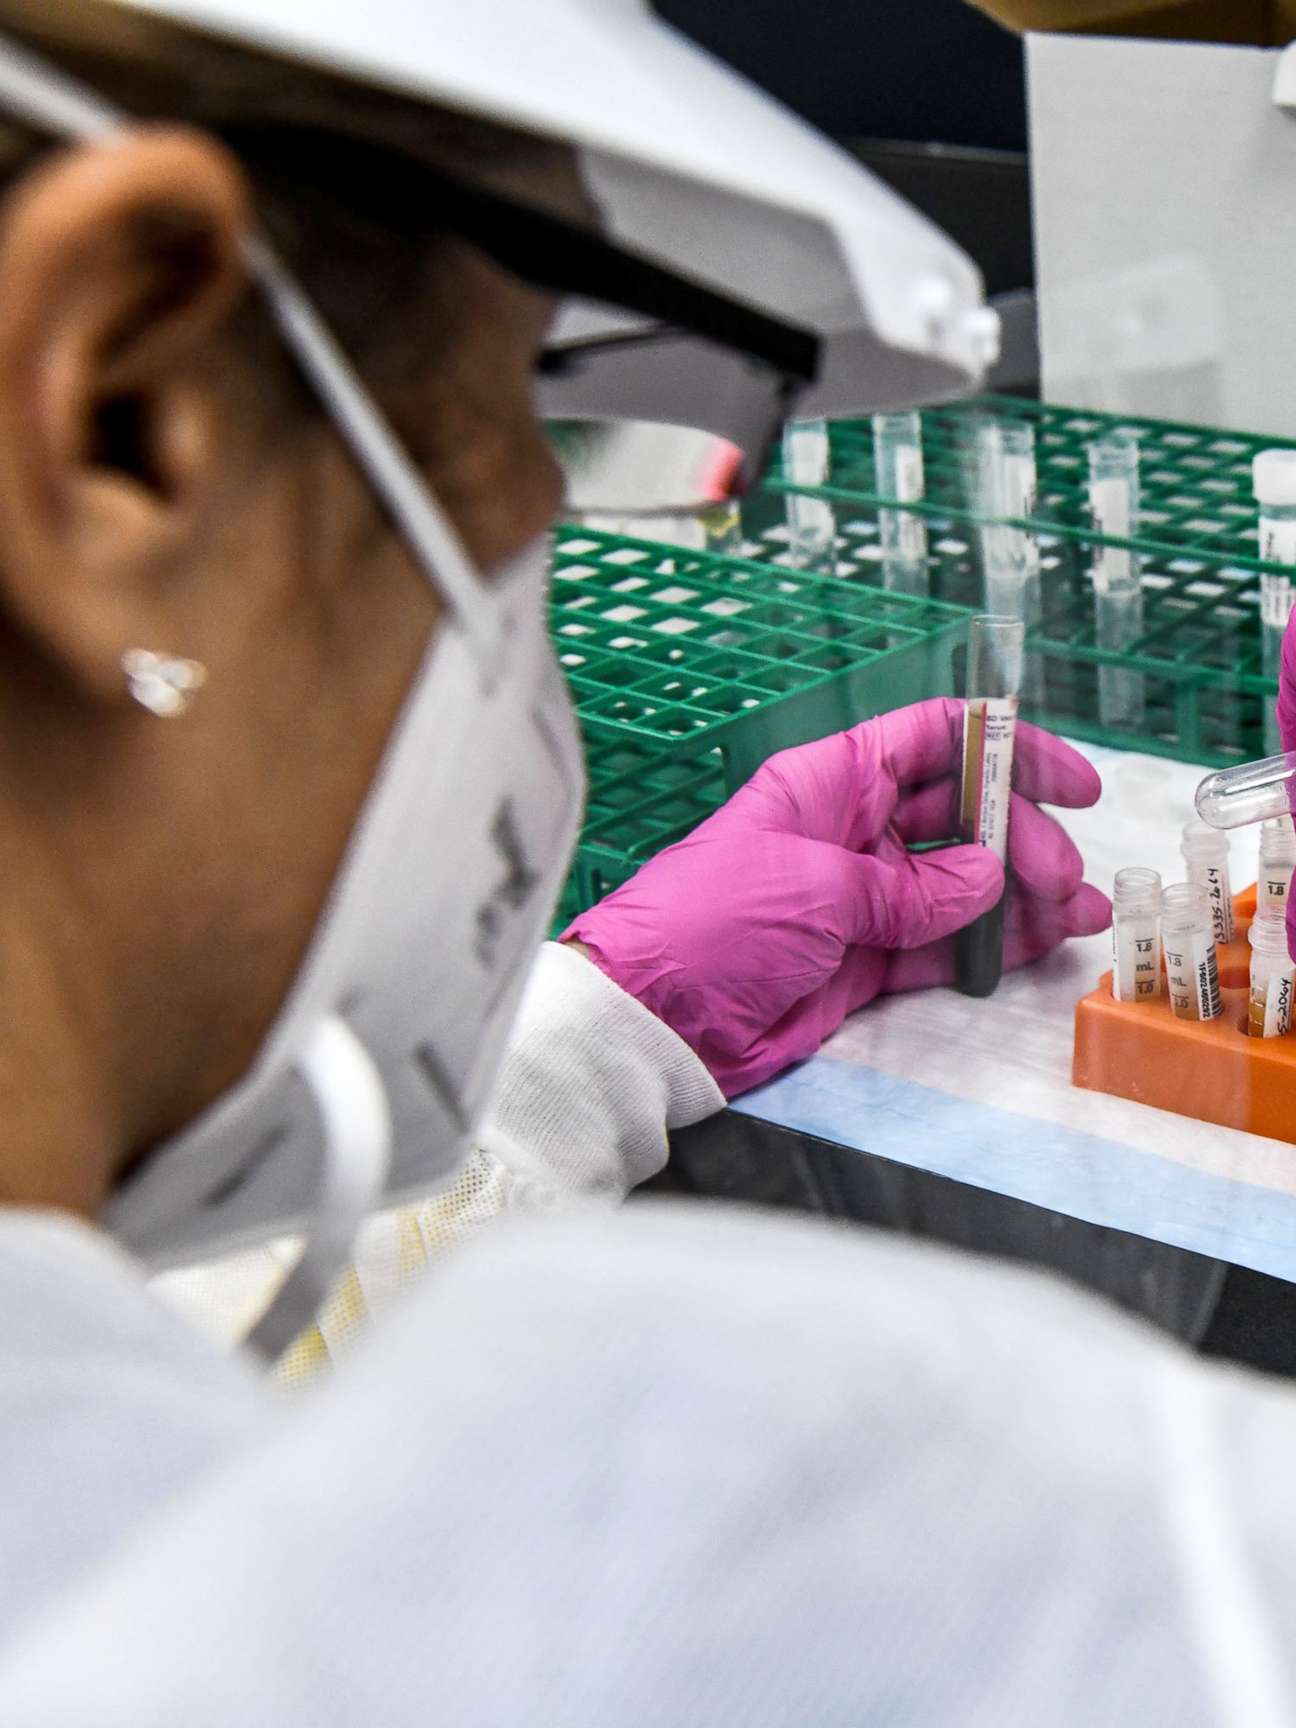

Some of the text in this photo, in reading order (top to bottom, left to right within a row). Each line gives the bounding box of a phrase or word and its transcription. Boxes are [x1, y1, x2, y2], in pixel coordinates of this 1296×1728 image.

[1268, 885, 1285, 896] 1.8
[1136, 942, 1153, 953] 1.8
[1136, 961, 1155, 972] mL
[1167, 954, 1183, 968] 1.8
[1137, 983, 1154, 994] 1.0
